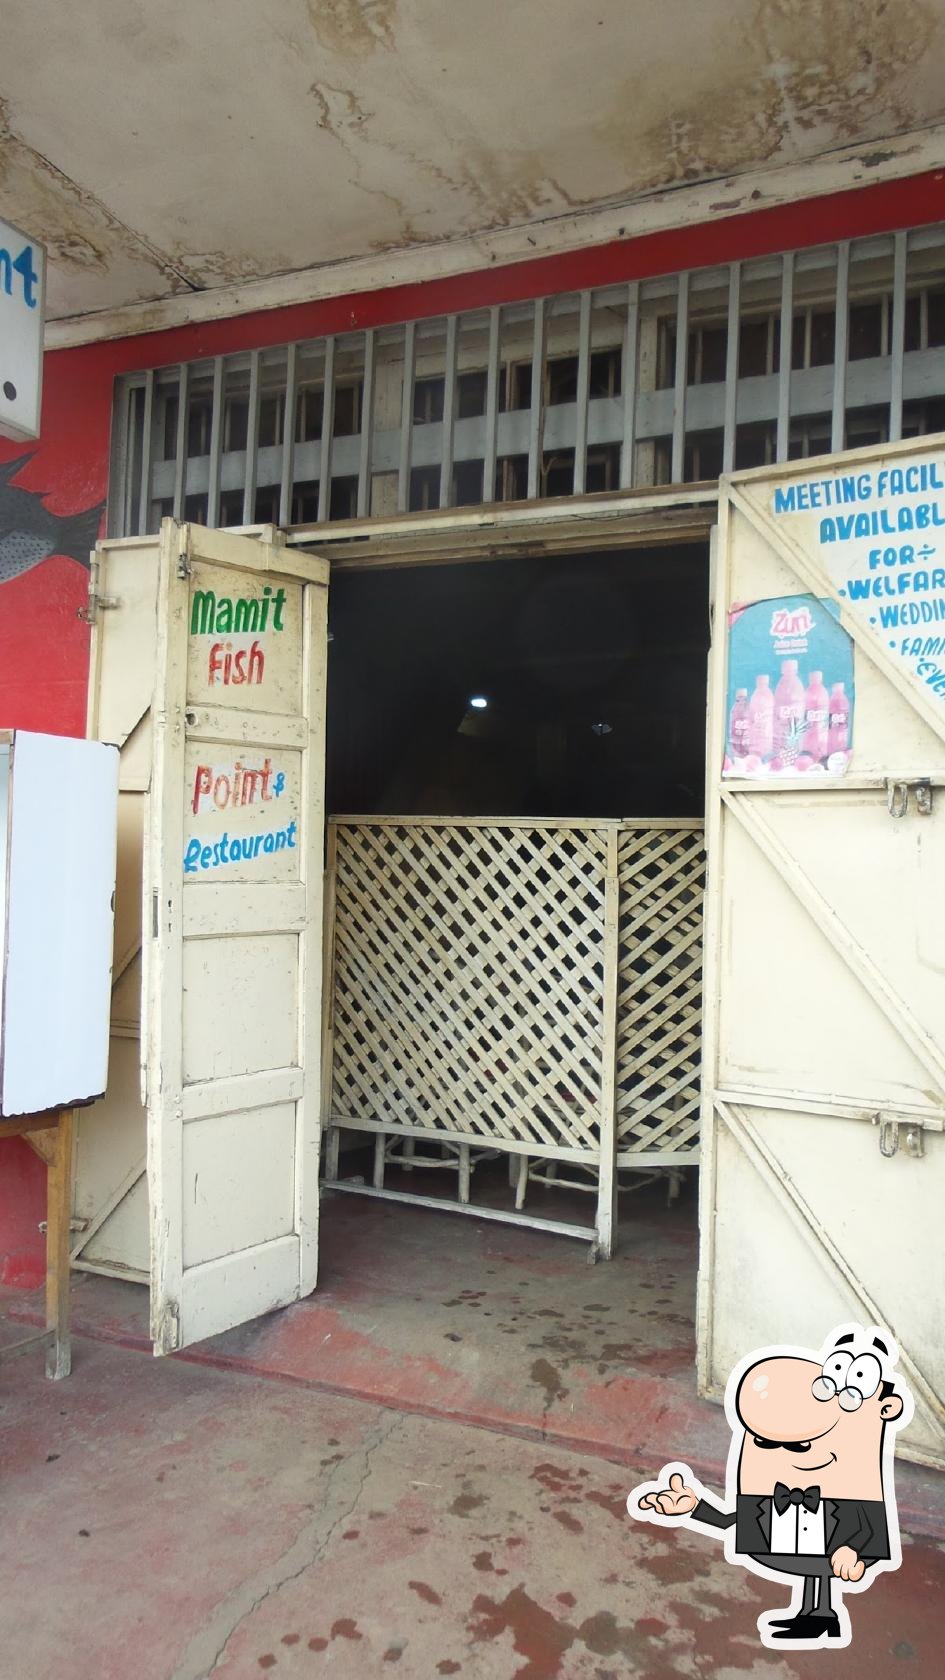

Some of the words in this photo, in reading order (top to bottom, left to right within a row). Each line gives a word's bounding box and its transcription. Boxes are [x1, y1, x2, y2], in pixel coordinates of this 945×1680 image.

[774, 474, 873, 514] MEETING
[820, 502, 945, 544] AVAILABL
[190, 586, 287, 635] Mamit
[207, 640, 266, 687] Fish
[191, 758, 273, 815] Point
[183, 821, 297, 873] Restaurant
